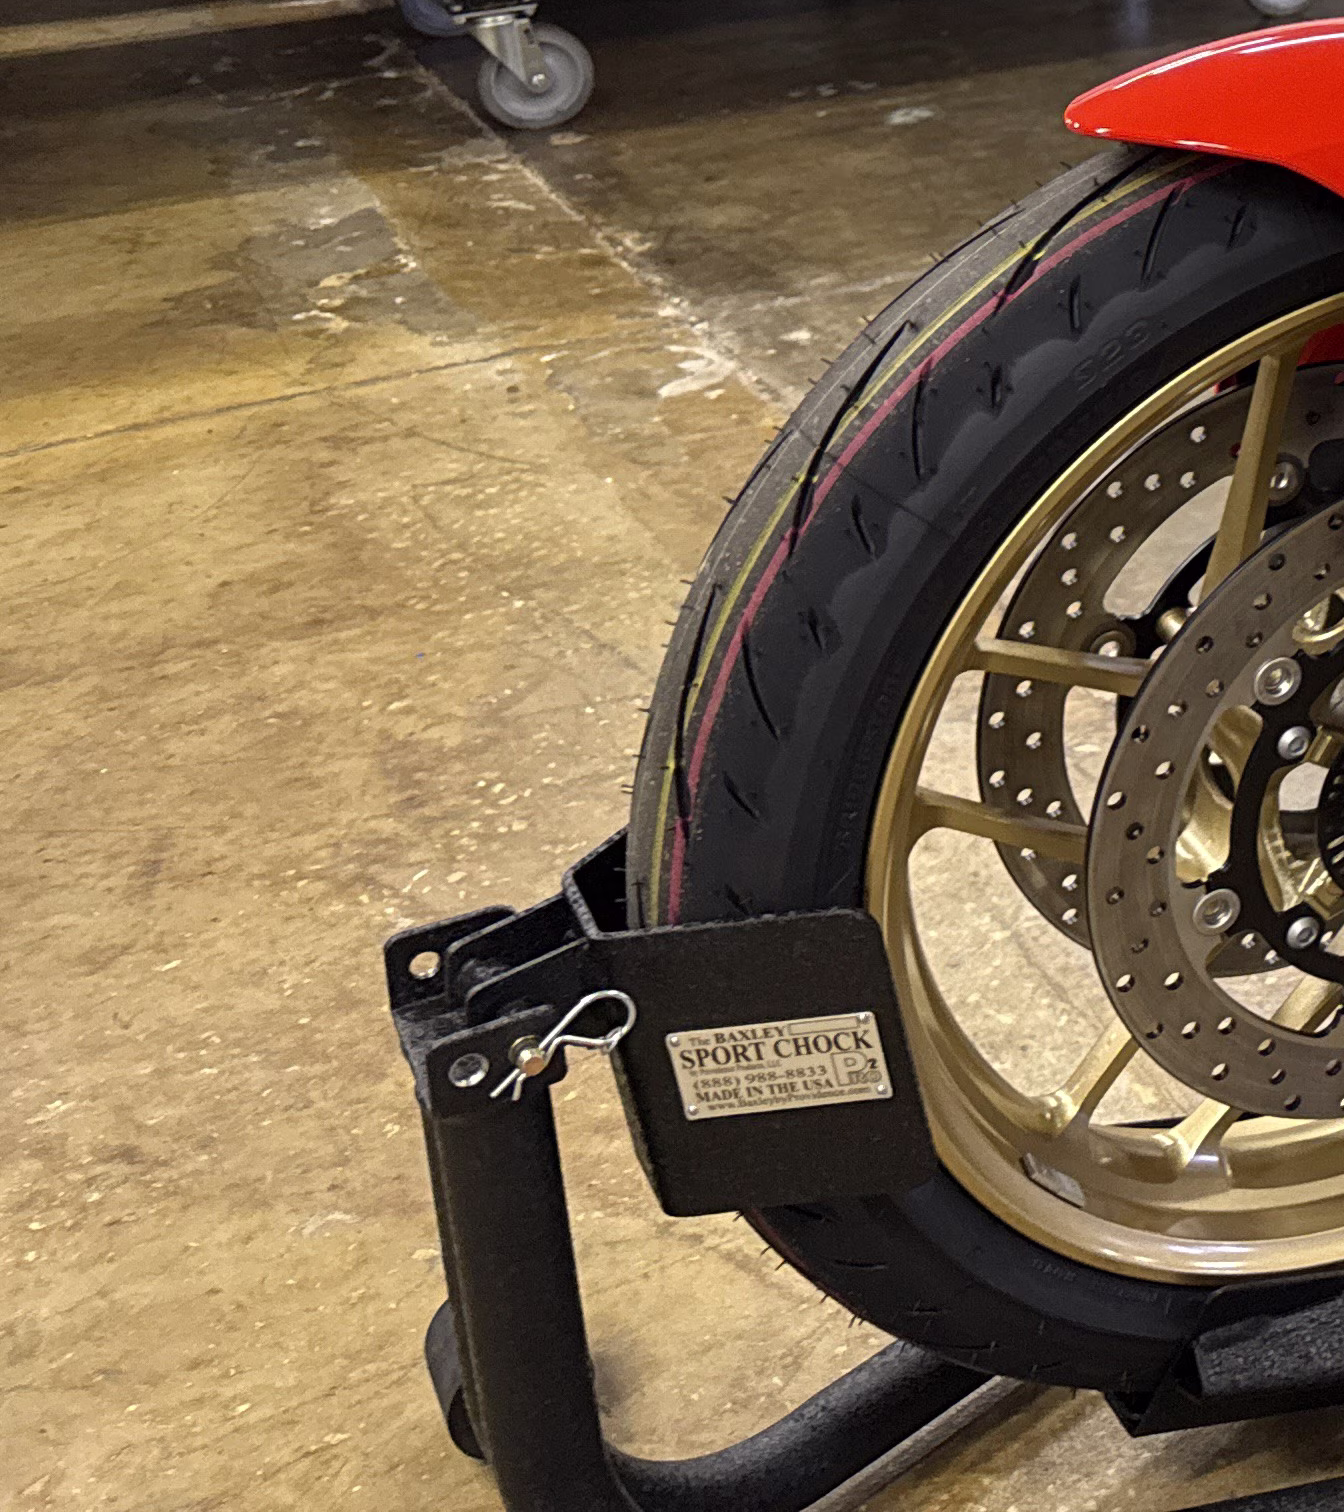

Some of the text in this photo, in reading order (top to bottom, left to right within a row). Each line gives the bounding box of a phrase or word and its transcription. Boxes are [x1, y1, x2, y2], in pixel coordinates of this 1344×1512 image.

[714, 1026, 786, 1044] BAXLEY
[680, 1029, 873, 1069] SPORT CHOCK
[693, 1065, 827, 1090] (888) 988-8833
[696, 1078, 833, 1102] MADE IN THE USA
